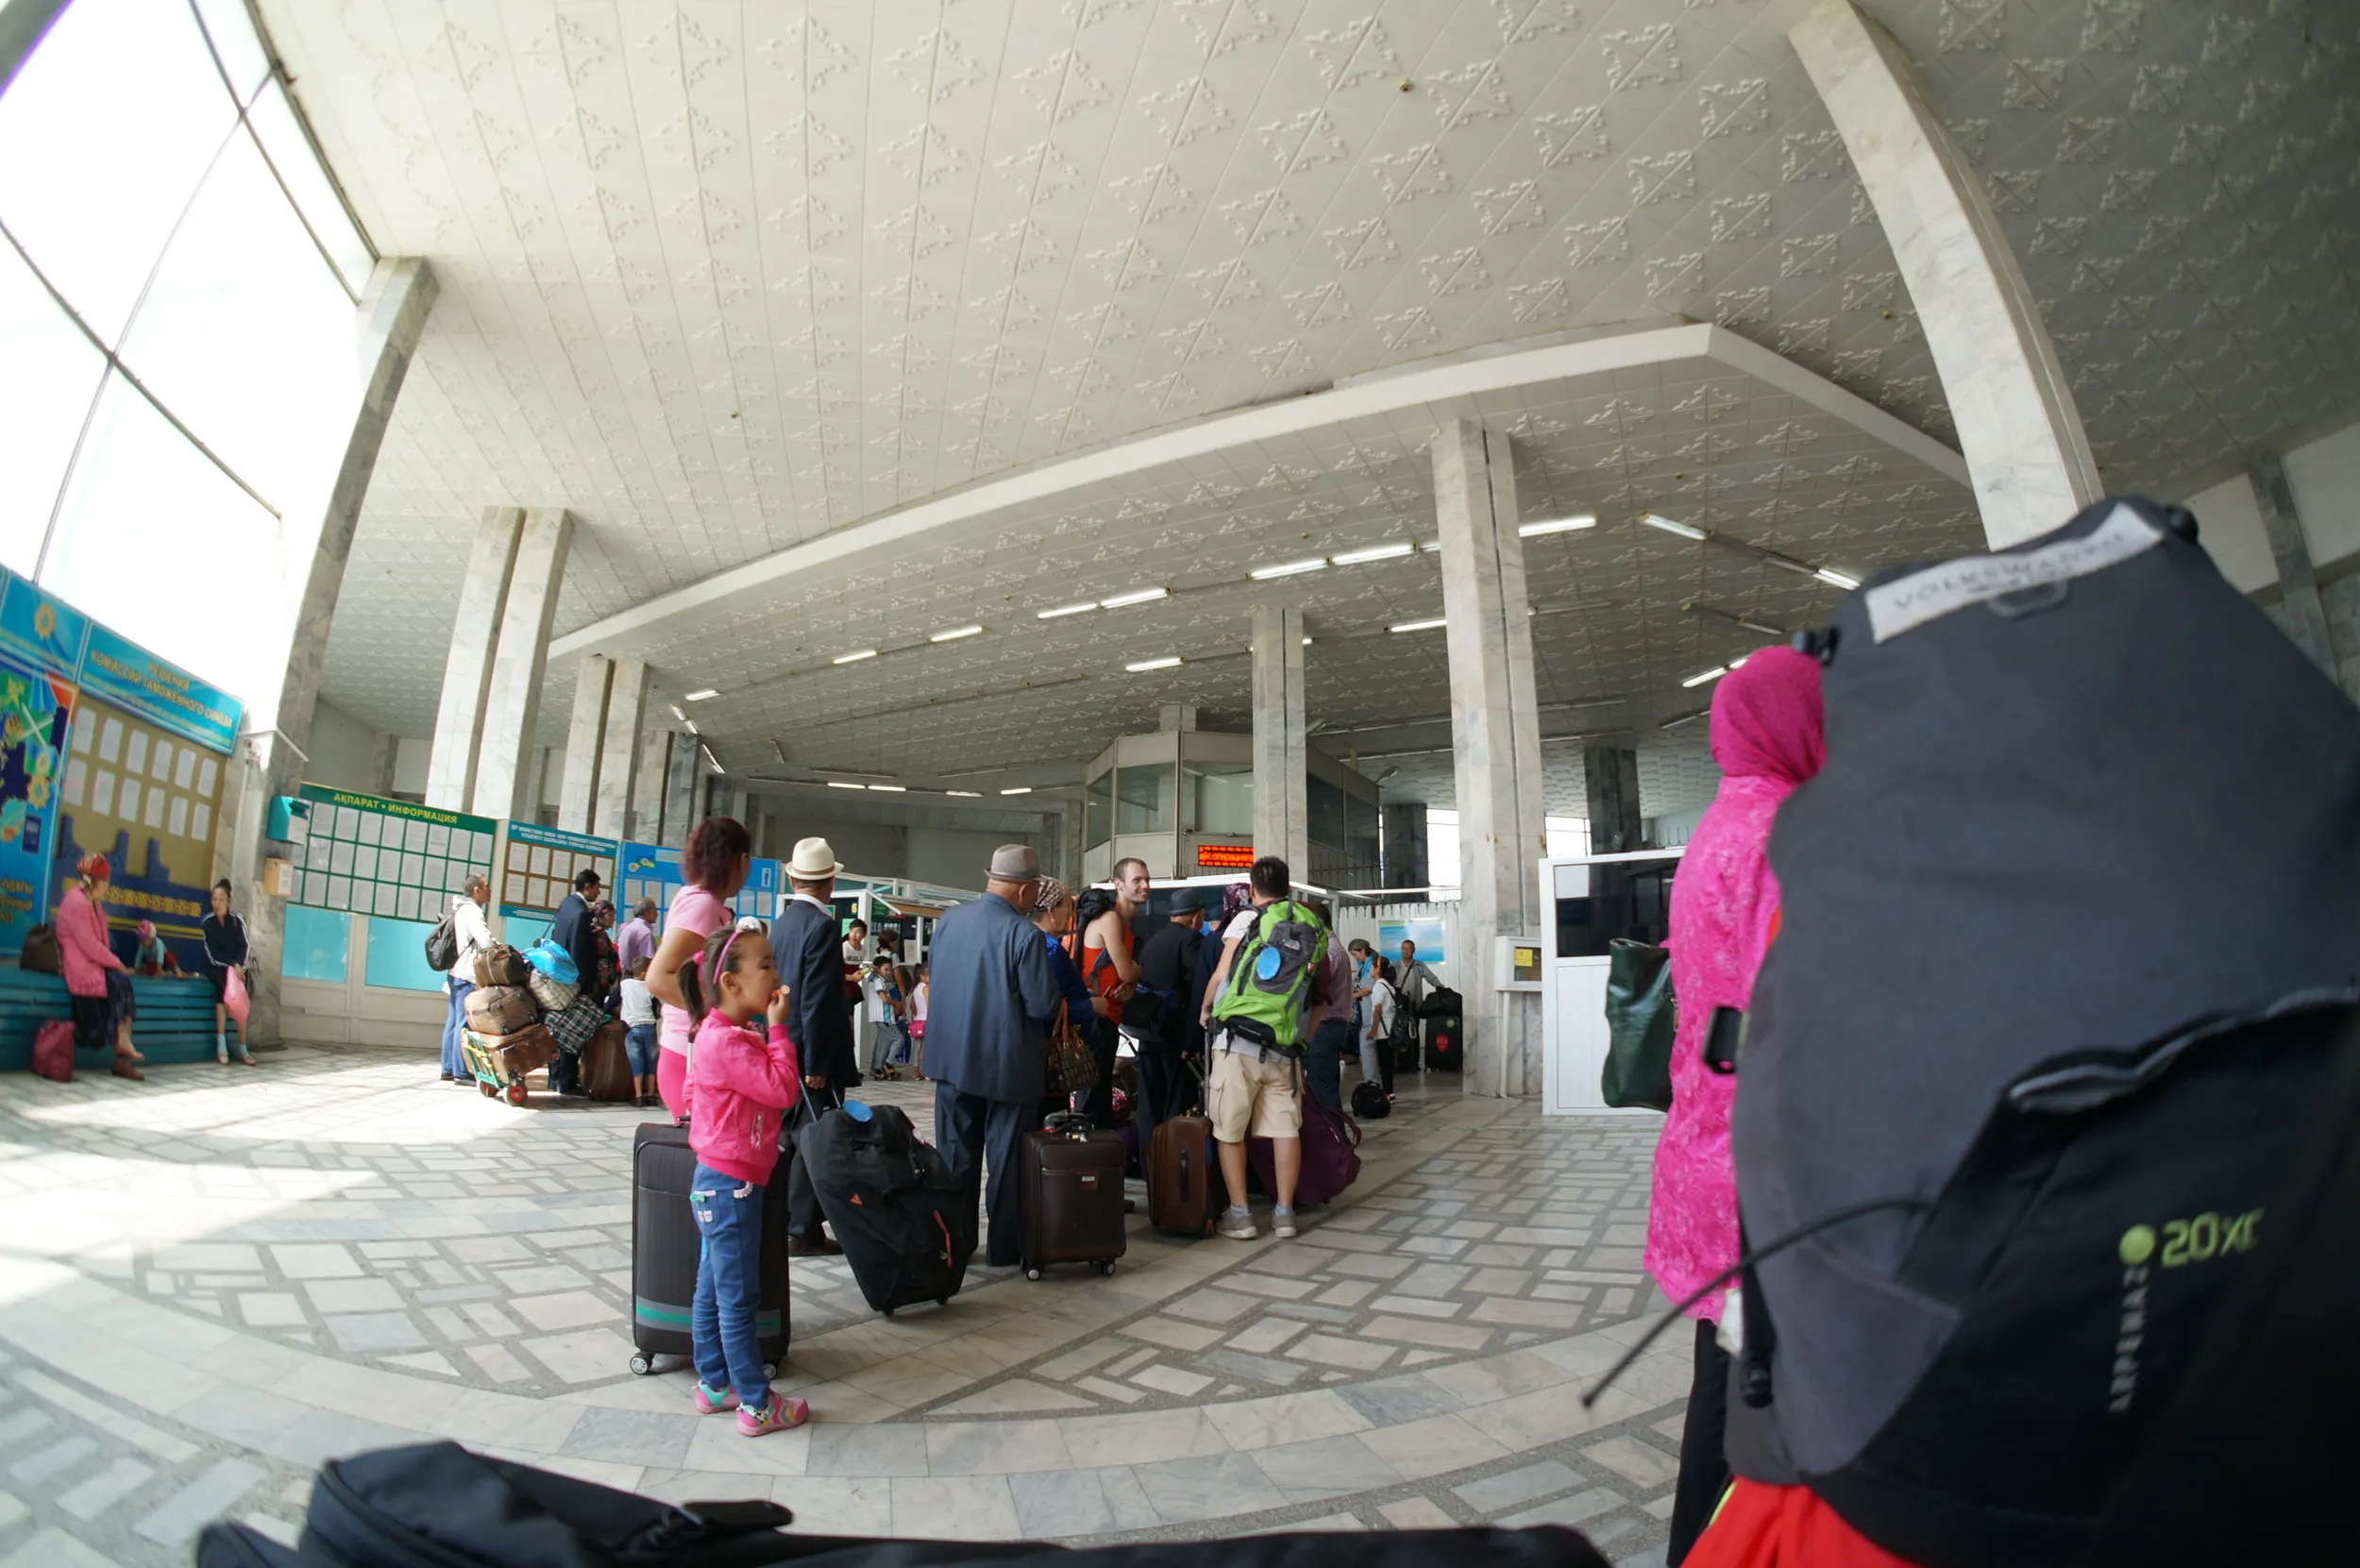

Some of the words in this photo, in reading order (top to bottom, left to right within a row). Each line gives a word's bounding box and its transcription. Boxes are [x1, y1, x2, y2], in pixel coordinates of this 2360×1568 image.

[333, 793, 379, 809] АҚПАРАТ
[388, 803, 458, 824] ИНФОРМАЦИЯ
[851, 902, 857, 913] 6
